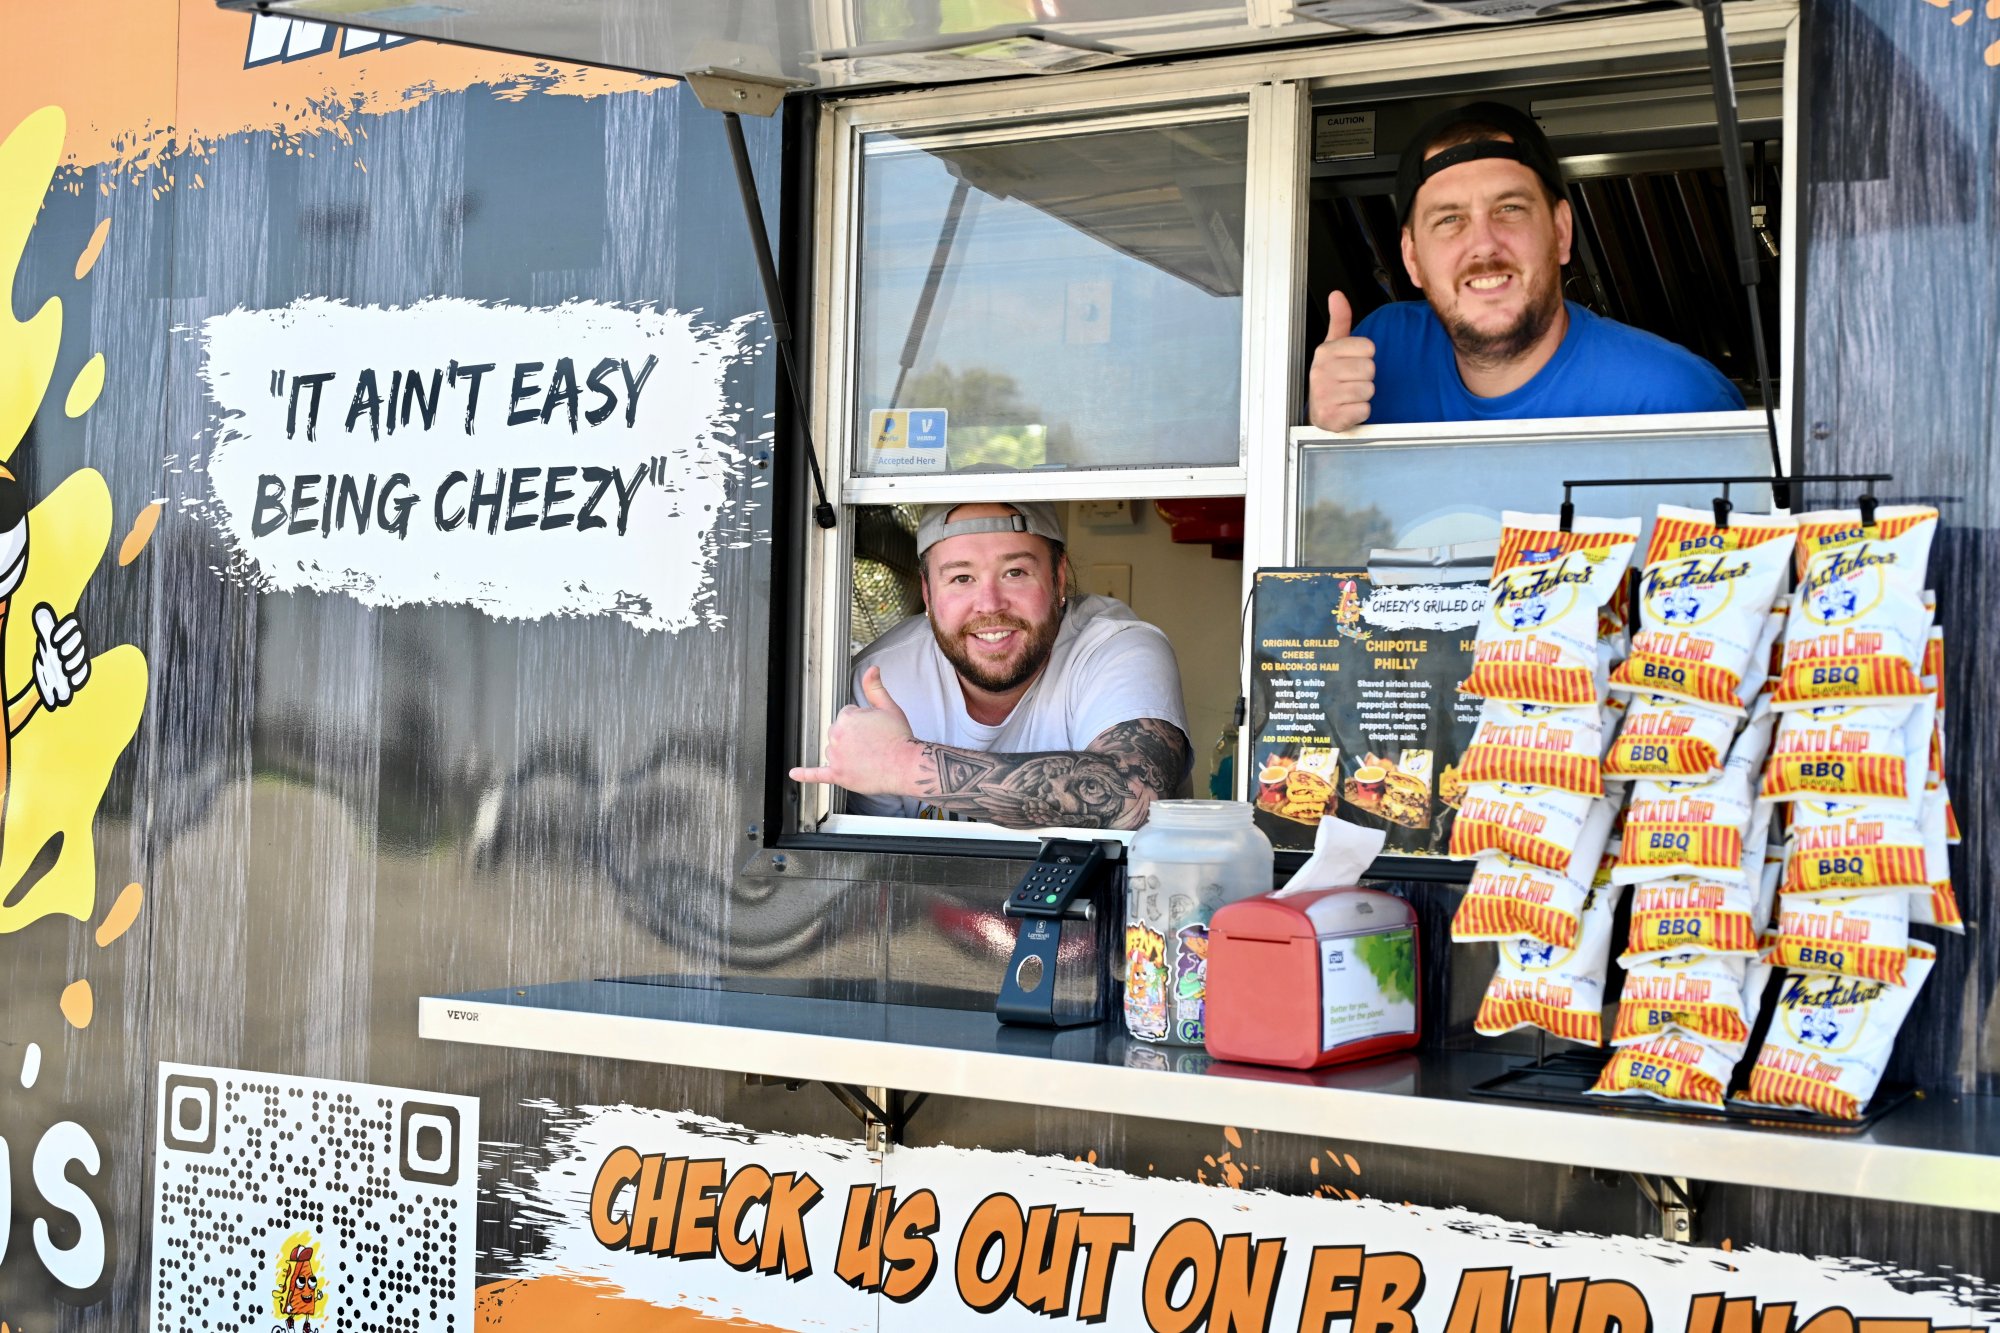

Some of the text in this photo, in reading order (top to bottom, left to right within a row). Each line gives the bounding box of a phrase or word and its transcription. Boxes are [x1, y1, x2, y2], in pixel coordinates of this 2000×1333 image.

[1328, 116, 1364, 126] CAUTION
[270, 354, 659, 442] "IT AIN'T EASY
[878, 456, 936, 467] Accepted Here
[251, 455, 668, 541] BEING CHEEZY"
[1680, 535, 1724, 551] BBQ
[1819, 528, 1864, 545] BBQ
[1372, 600, 1420, 613] CHEEZY'S
[1424, 600, 1468, 613] GRILLED
[1262, 639, 1339, 648] ORIGINAL GRILLED
[1365, 640, 1427, 652] CHIPOTLE
[1843, 627, 1883, 657] CHIP
[1282, 651, 1314, 659] CHEESE
[1261, 663, 1339, 671] OG BACON-OG HAM
[1374, 658, 1418, 670] PHILLY
[1644, 663, 1686, 685] BBQ
[1812, 666, 1860, 685] BBQ
[1270, 679, 1325, 687] Yellow & white
[1357, 680, 1432, 689] Shaved sirloin steak,
[1275, 690, 1318, 700] extra gooey
[1362, 690, 1426, 699] white American &
[1274, 701, 1308, 709] American
[1357, 701, 1431, 711] pepperjack cheeses,
[1454, 703, 1473, 711] ham,
[1269, 712, 1325, 722] buttery toasted
[1361, 711, 1426, 721] roasted red-green
[1657, 710, 1696, 736] CHIP
[1276, 723, 1316, 733] sourdough.
[1393, 722, 1419, 731] onions,
[1302, 736, 1312, 744] OR
[1313, 736, 1330, 744] HAM
[1369, 732, 1417, 742] chipotle aioli.
[1479, 721, 1533, 748] POTATO
[1534, 721, 1574, 752] CHIP
[1829, 724, 1869, 753] CHIP
[1630, 745, 1669, 764] BBQ
[1800, 762, 1845, 780] BBQ
[1677, 795, 1715, 823] CHIP
[1508, 801, 1547, 835] CHIP
[1650, 832, 1690, 852] BBQ
[1845, 818, 1884, 849] CHIP
[1818, 857, 1864, 876] BBQ
[1516, 873, 1555, 906] CHIP
[1687, 882, 1725, 910] CHIP
[1657, 918, 1702, 937] BBQ
[1830, 910, 1870, 944] CHIP
[1799, 947, 1845, 969] BBQ
[1536, 976, 1573, 1009] CHIP
[1673, 973, 1712, 1003] CHIP
[447, 1010, 479, 1021] VEVOR
[1630, 1061, 1671, 1087] BBQ
[589, 1145, 824, 1283] CHECK
[834, 1183, 940, 1304] US
[955, 1192, 1136, 1325] OUT
[1142, 1217, 1287, 1333] ON
[1298, 1244, 1426, 1333] FB
